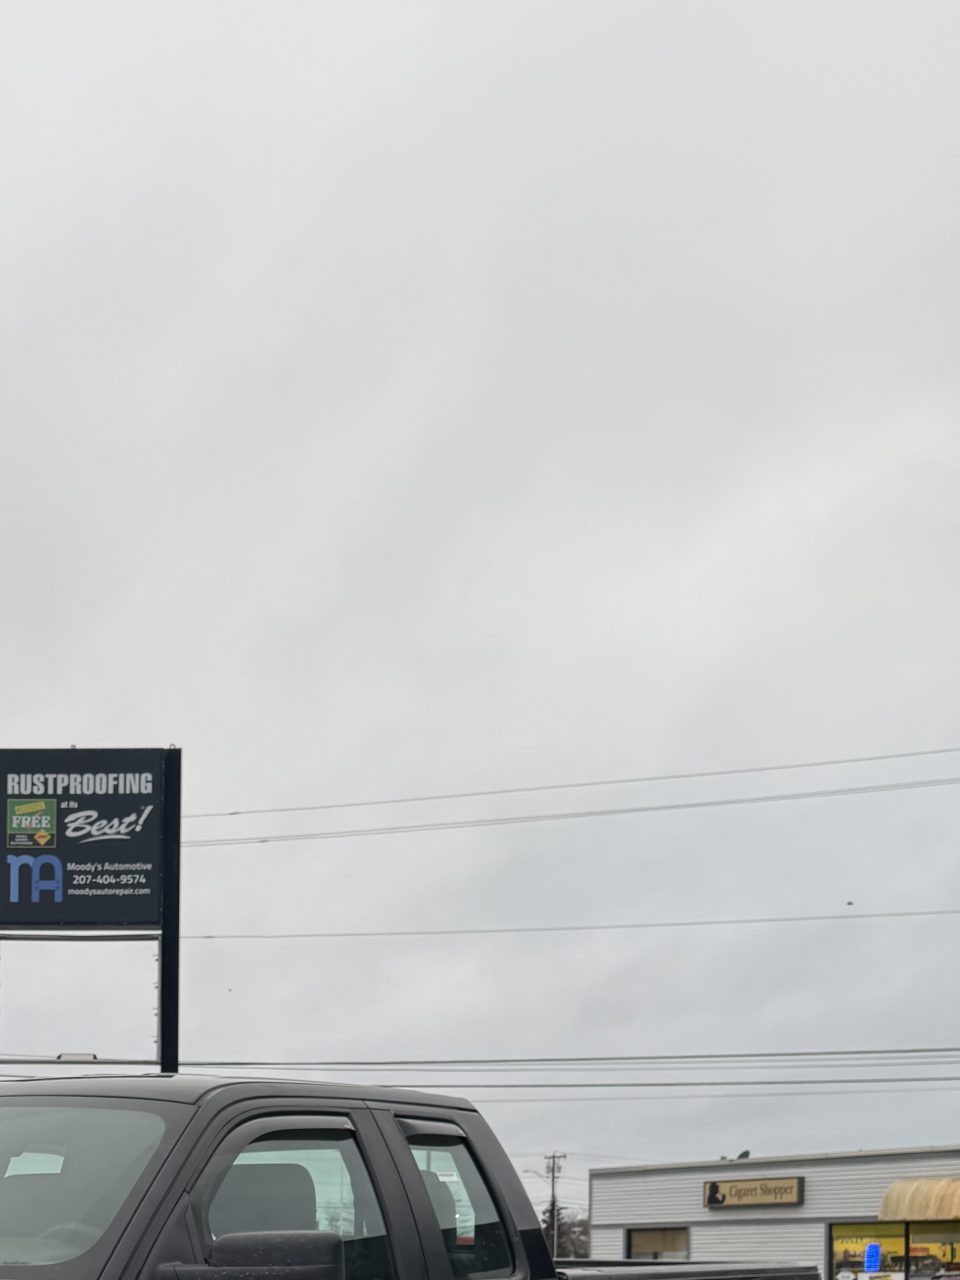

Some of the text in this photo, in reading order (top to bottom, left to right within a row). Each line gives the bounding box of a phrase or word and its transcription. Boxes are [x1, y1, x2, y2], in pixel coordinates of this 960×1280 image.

[6, 773, 153, 795] RUSTPROOFING
[12, 815, 51, 828] FREE
[64, 805, 154, 838] Best!
[67, 861, 153, 873] Moody's Automotive
[72, 874, 147, 885] 207-404-9574
[67, 887, 151, 897] moodysautorepair.com
[728, 1182, 795, 1202] Cigaret Shopper
